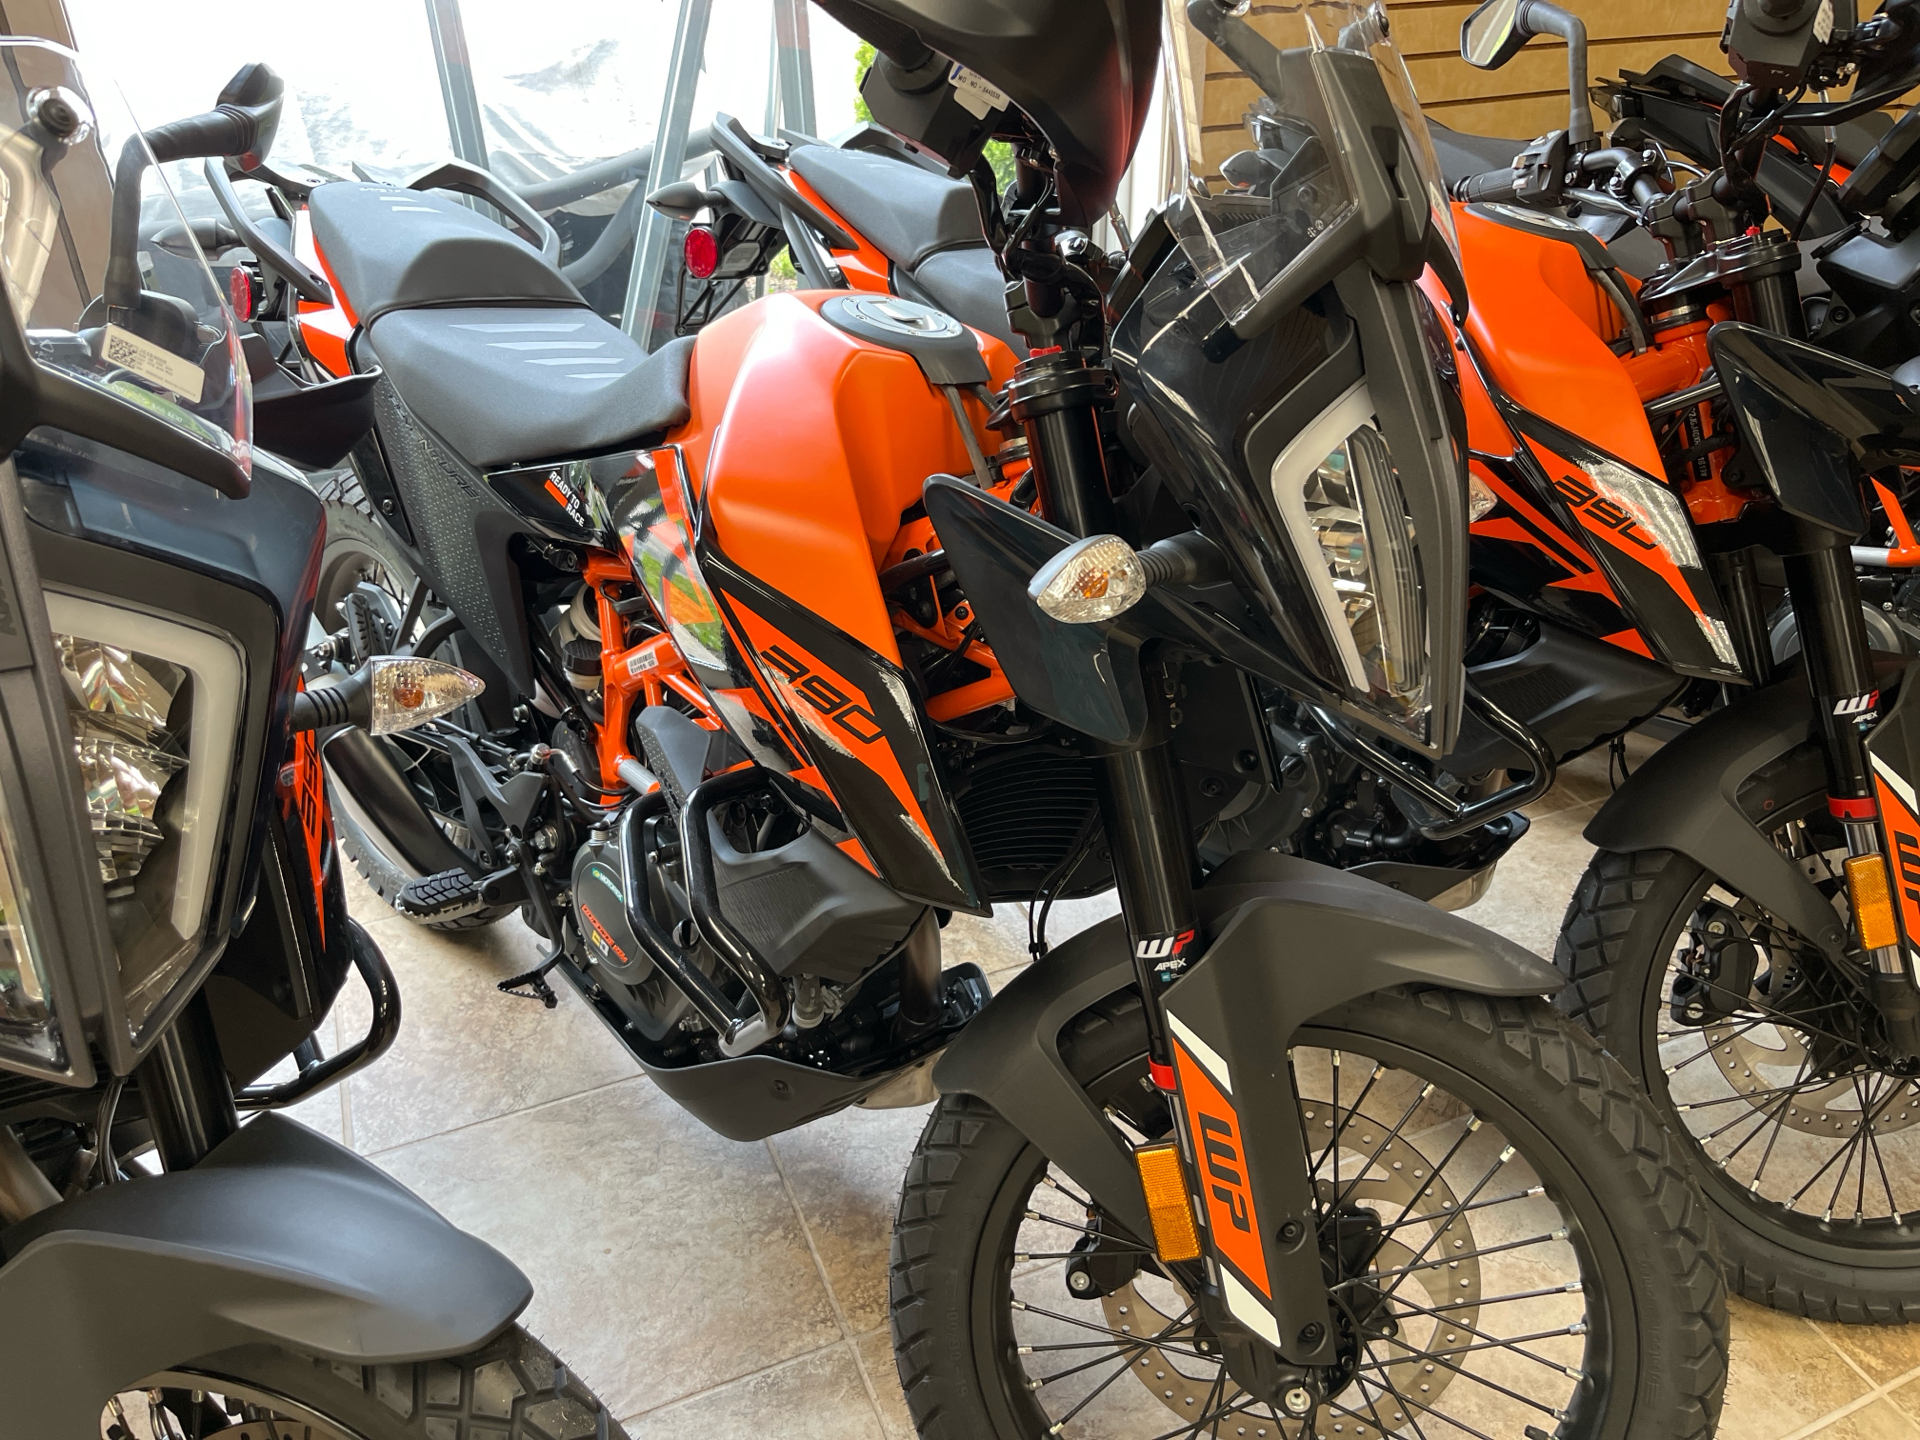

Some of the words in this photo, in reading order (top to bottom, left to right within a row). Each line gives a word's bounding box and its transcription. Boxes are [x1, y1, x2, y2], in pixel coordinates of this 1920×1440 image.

[549, 471, 572, 498] READY
[570, 494, 580, 509] TO
[566, 503, 585, 527] RACE
[760, 644, 884, 745] 390
[1852, 710, 1878, 724] APEX
[1136, 929, 1195, 959] WP
[1153, 957, 1187, 972] APEX
[1197, 1111, 1251, 1234] WP
